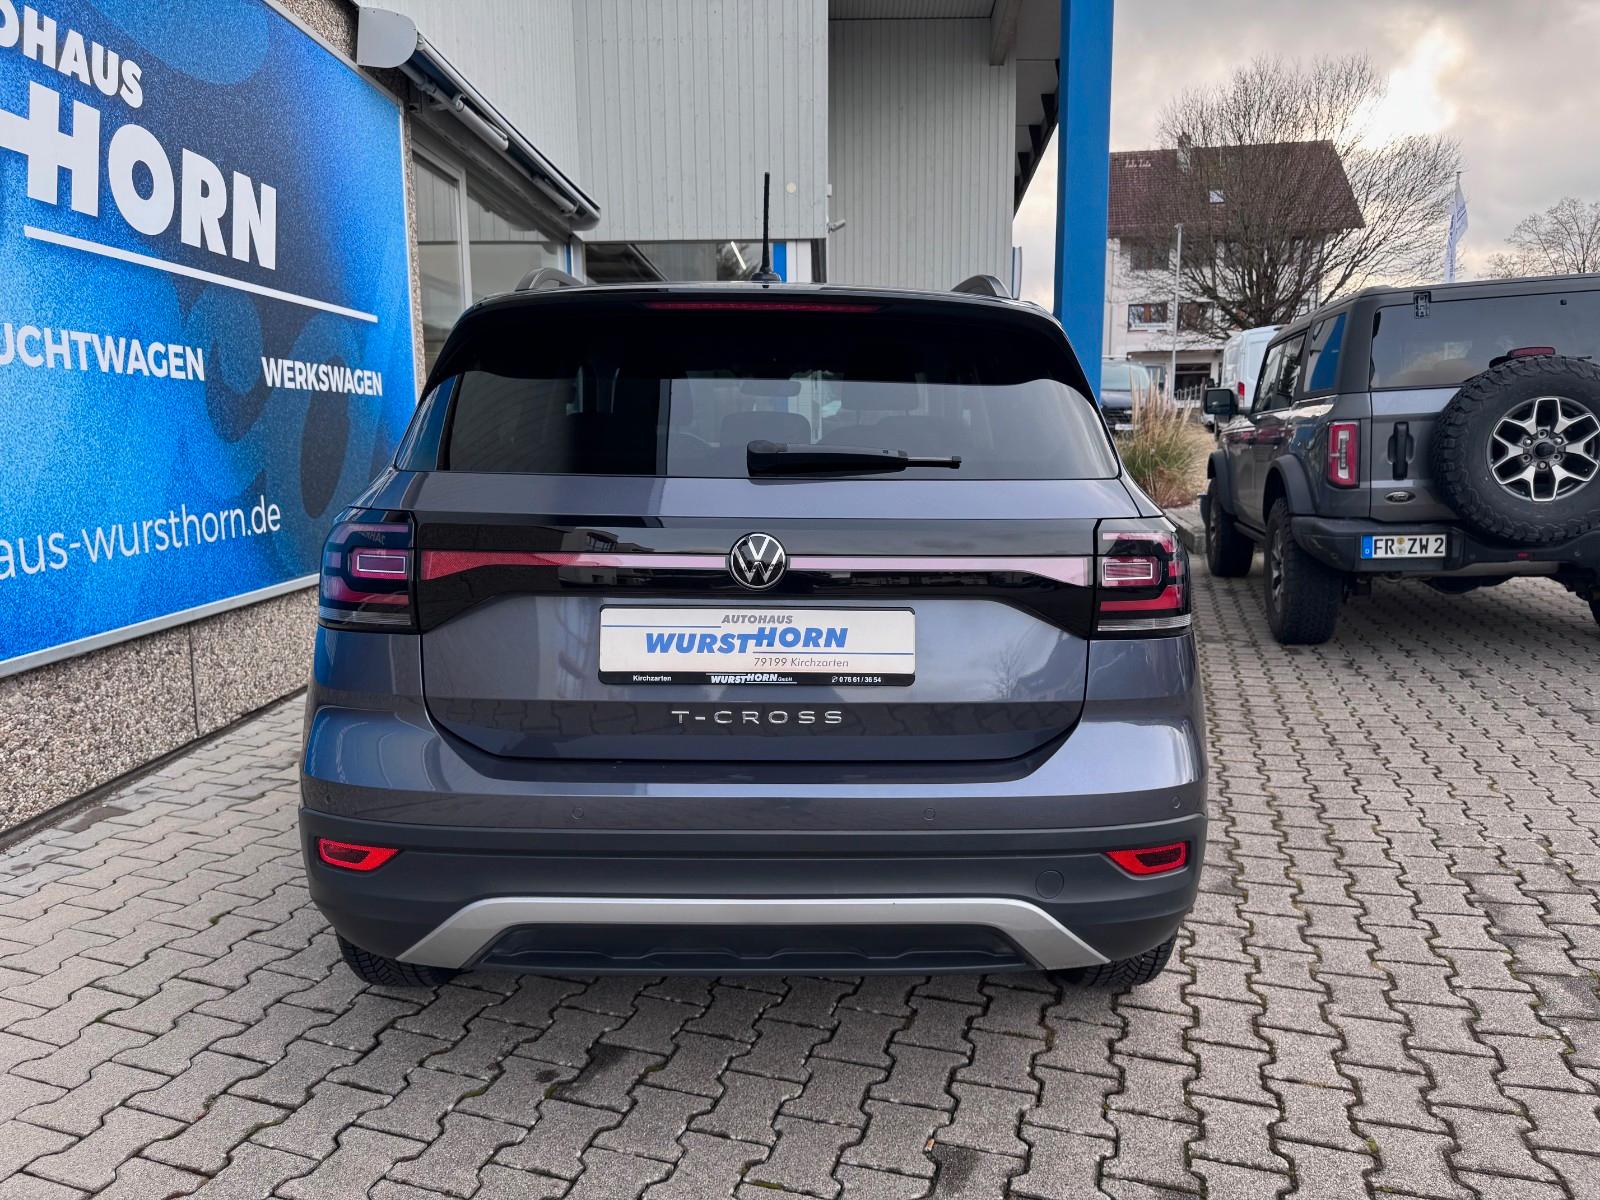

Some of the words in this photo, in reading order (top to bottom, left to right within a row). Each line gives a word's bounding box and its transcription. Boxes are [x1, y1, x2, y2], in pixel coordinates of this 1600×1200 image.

[262, 356, 383, 396] WERKSWAGEN
[1374, 539, 1395, 555] FR
[1408, 538, 1430, 554] ZW
[1434, 537, 1444, 554] 2
[721, 614, 793, 624] AUTOHAUS
[645, 627, 848, 654] WURSTHORN
[754, 657, 787, 668] 79199
[790, 657, 849, 669] Kirchzarten
[632, 674, 672, 682] Kirchzarten
[711, 674, 778, 684] WURSTHORN
[671, 710, 843, 724] T-CROSS
